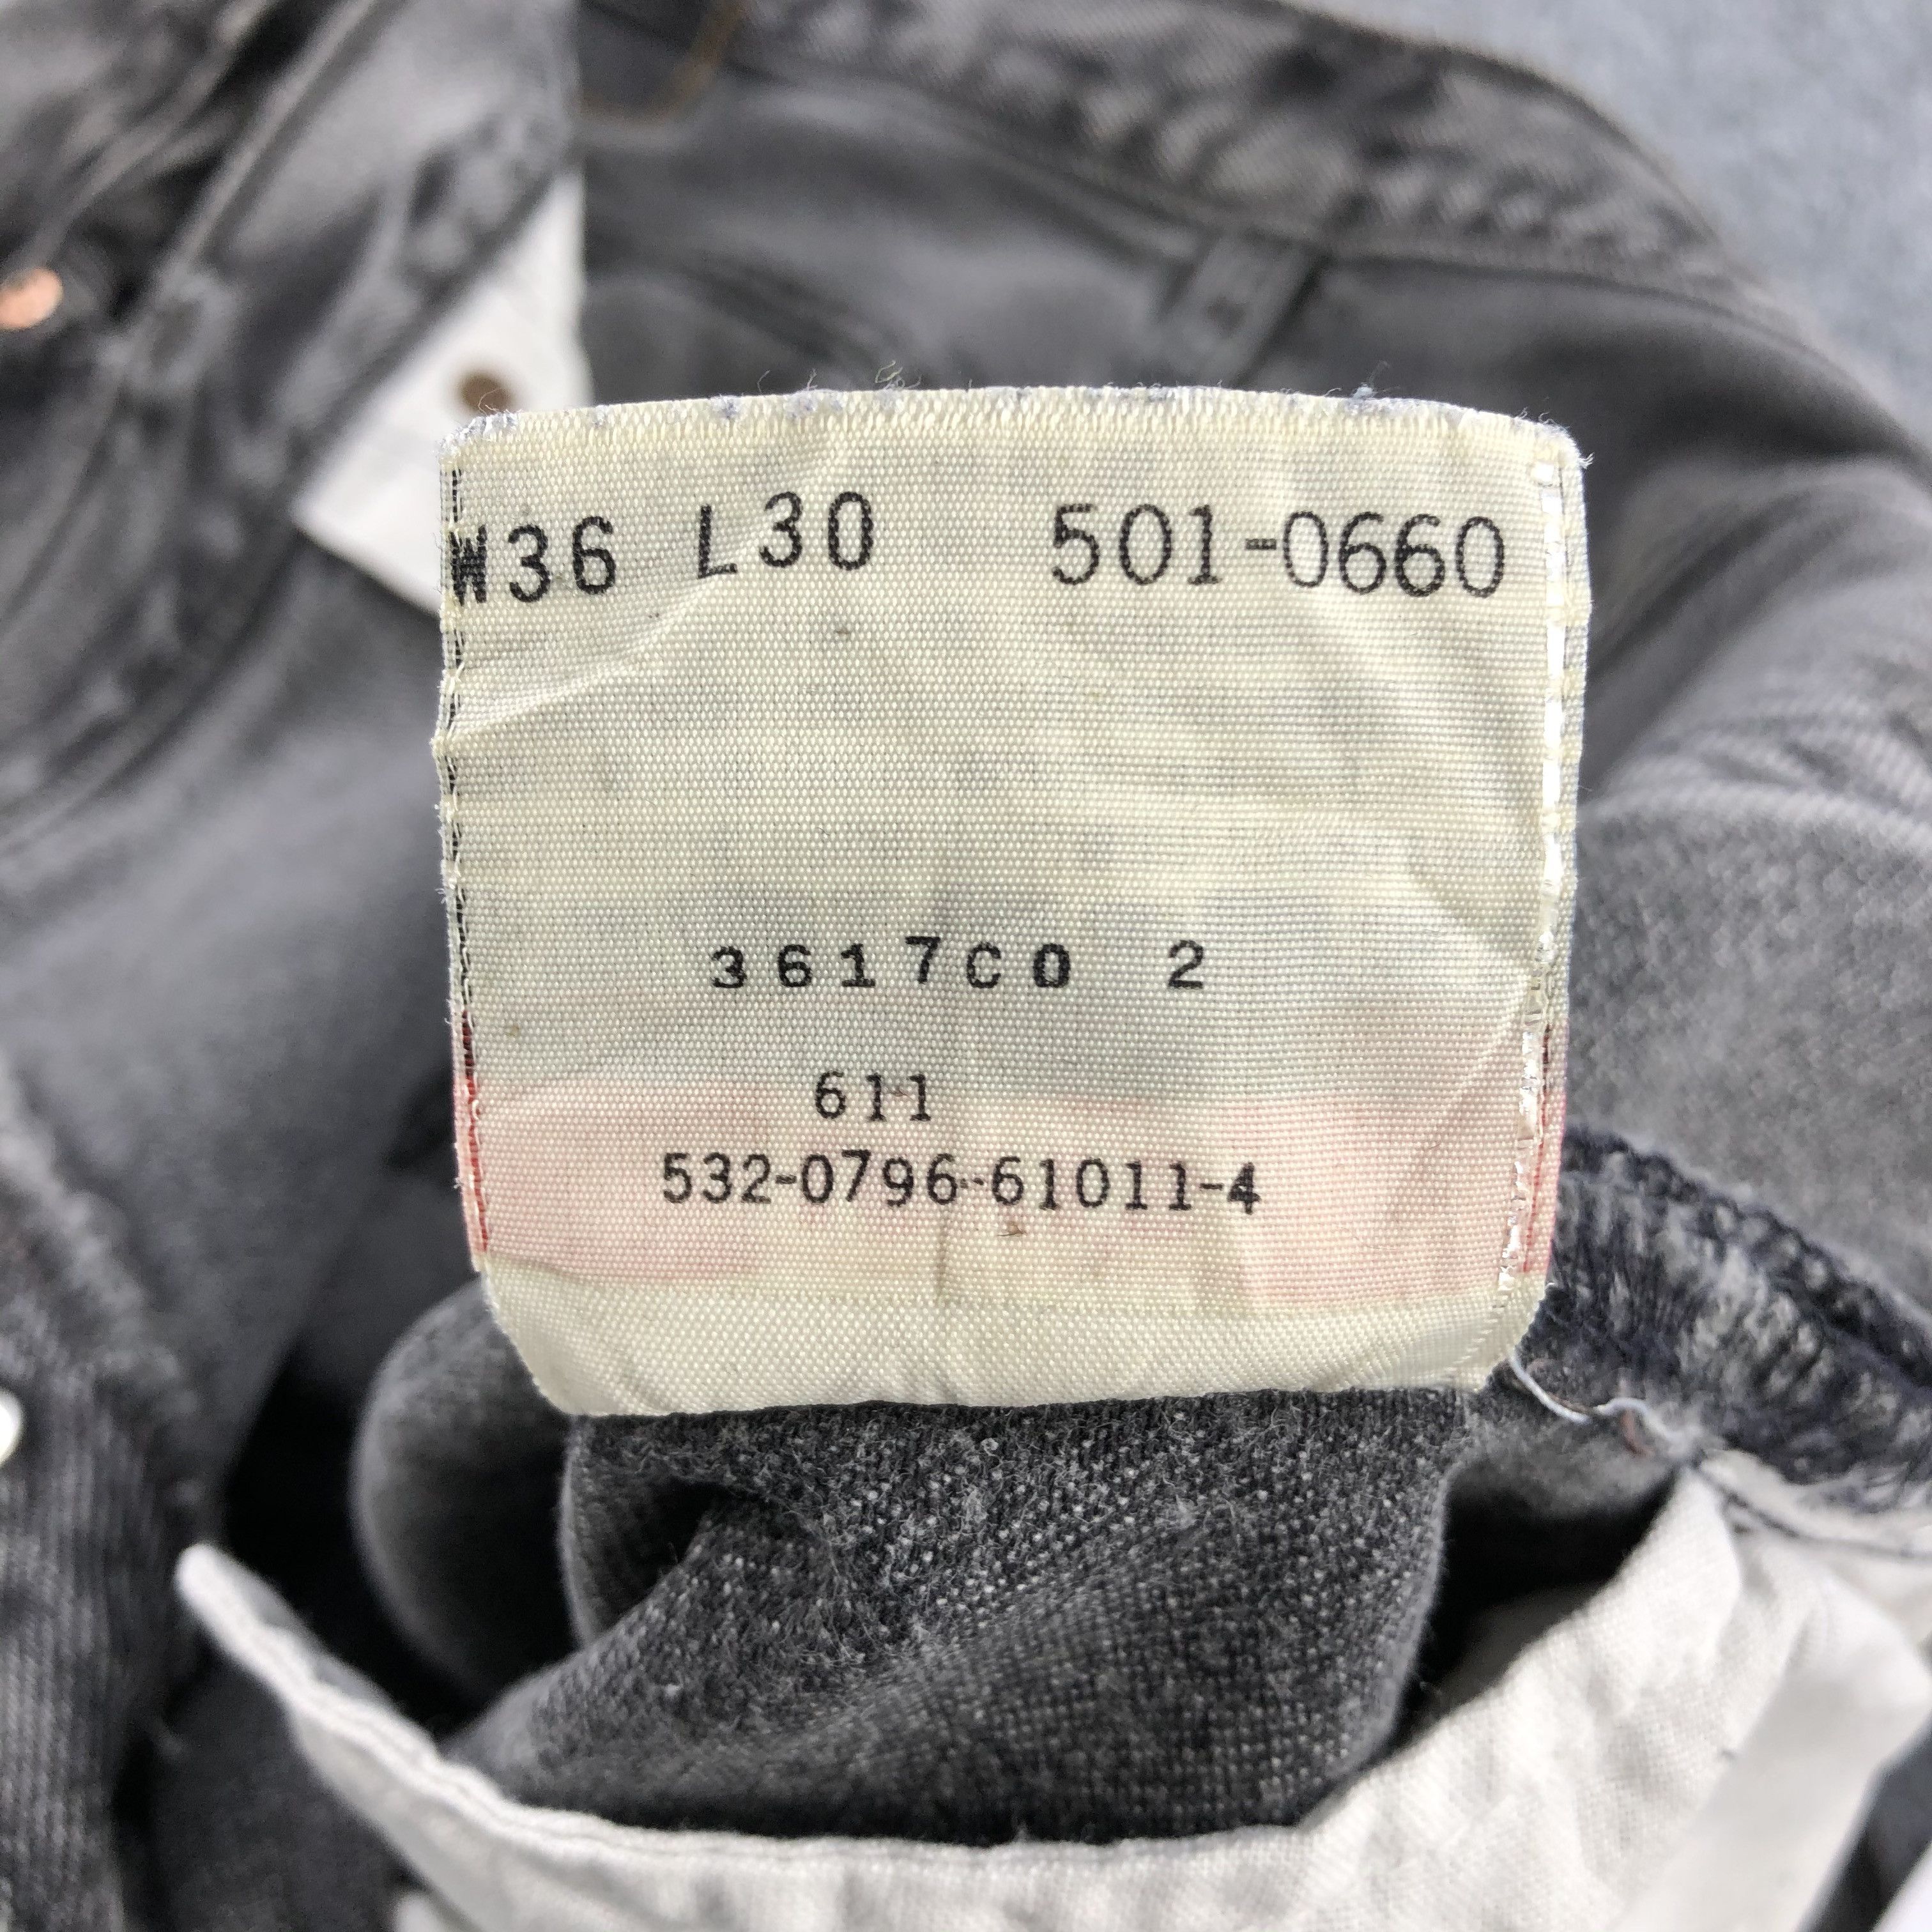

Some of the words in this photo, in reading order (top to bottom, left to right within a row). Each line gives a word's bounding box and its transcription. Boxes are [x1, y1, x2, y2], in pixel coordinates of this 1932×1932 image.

[450, 516, 617, 606] W36
[698, 491, 875, 579] L30
[1051, 503, 1506, 597] 501-0660
[1168, 939, 1205, 990] 2
[814, 1070, 931, 1122] 611
[662, 1149, 1261, 1214] 532-0796-61011-4
